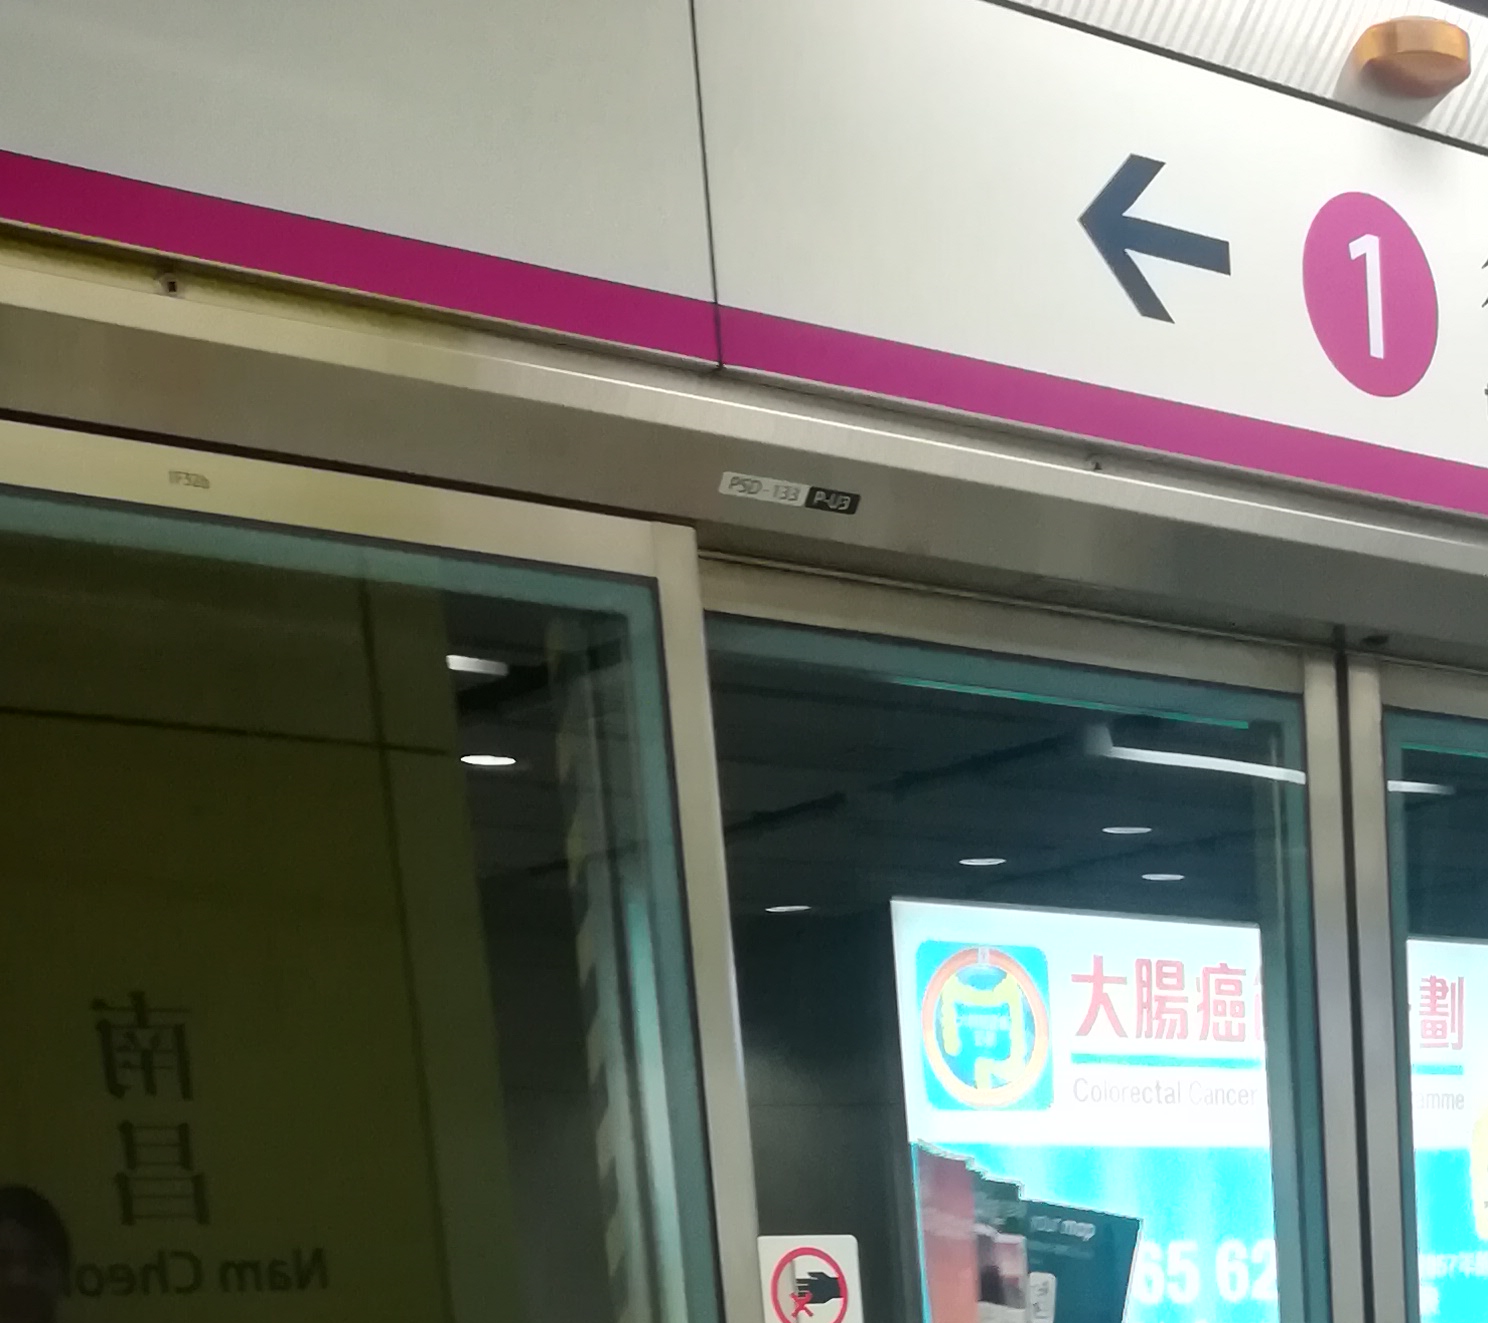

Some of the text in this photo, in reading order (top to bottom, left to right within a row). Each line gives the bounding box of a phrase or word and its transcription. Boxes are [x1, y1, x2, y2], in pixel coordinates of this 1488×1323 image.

[1348, 233, 1385, 359] 1
[1419, 974, 1465, 1051] 劃
[1072, 1077, 1182, 1106] Colorectal
[1189, 1080, 1258, 1106] Cancer
